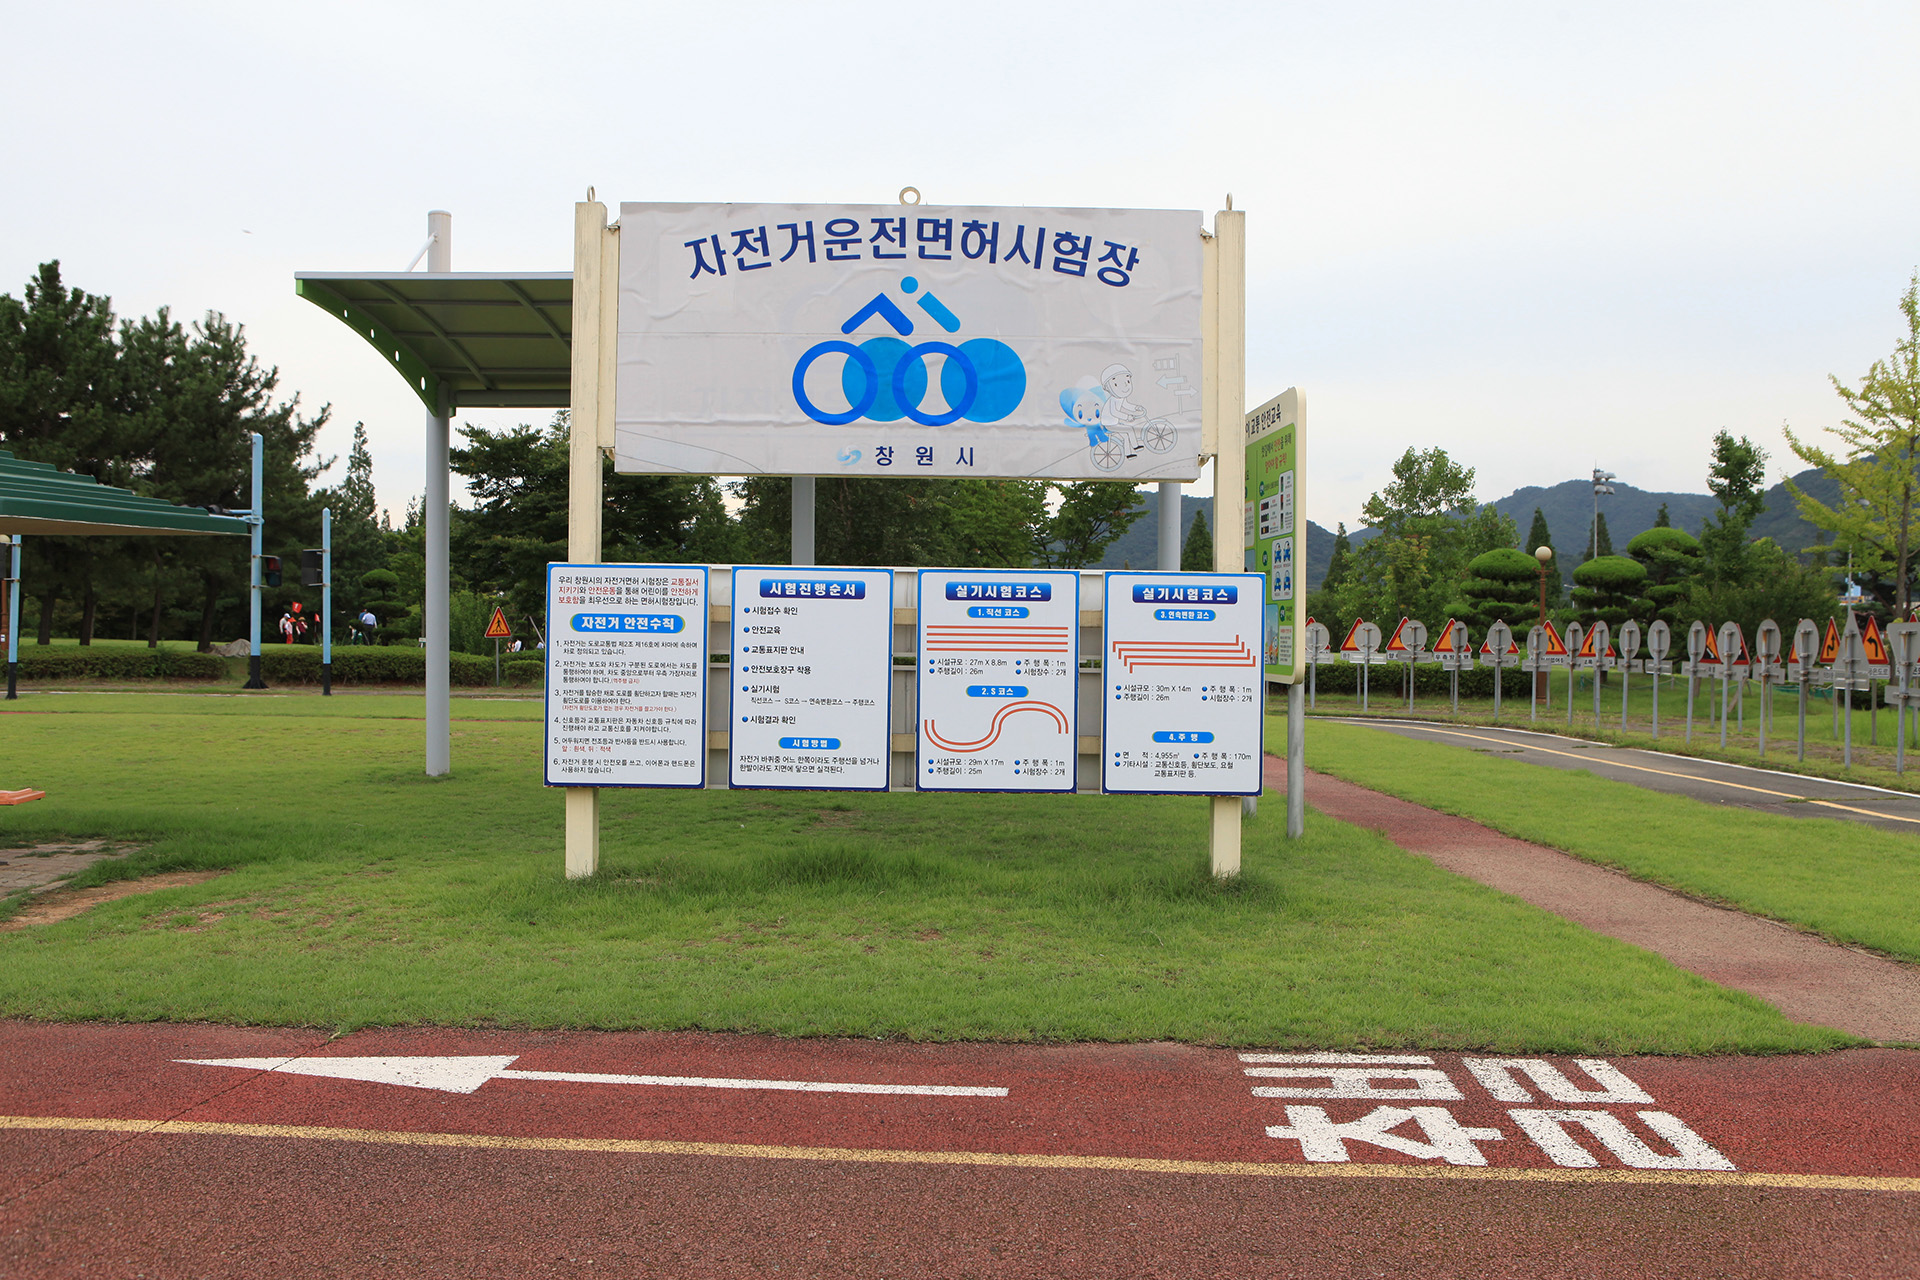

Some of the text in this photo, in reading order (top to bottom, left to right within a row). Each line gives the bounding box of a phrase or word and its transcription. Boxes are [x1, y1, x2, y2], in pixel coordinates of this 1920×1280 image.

[683, 216, 1140, 288] 자전거운전면허시험장
[559, 576, 698, 586] 우리 창원시의 자전거면허 시험장은 교통질서
[625, 587, 639, 595] 통해
[671, 588, 698, 596] 안전하게
[770, 582, 856, 596] 시험진행순서
[956, 585, 1042, 598] 실기시험코스
[1143, 588, 1228, 601] 실기시험코스
[559, 596, 698, 606] 보호함을 최우선으로 하는 면허시험장입니다.
[753, 607, 797, 615] 시험접수 확인
[582, 617, 674, 630] 자전거 안전수칙
[752, 626, 780, 634] 안전교육
[752, 646, 804, 654] 교통표지판 안내
[751, 665, 811, 674] 안전보호장구 착용
[751, 685, 779, 693] 실기시험
[751, 716, 795, 724] 시험결과 확인
